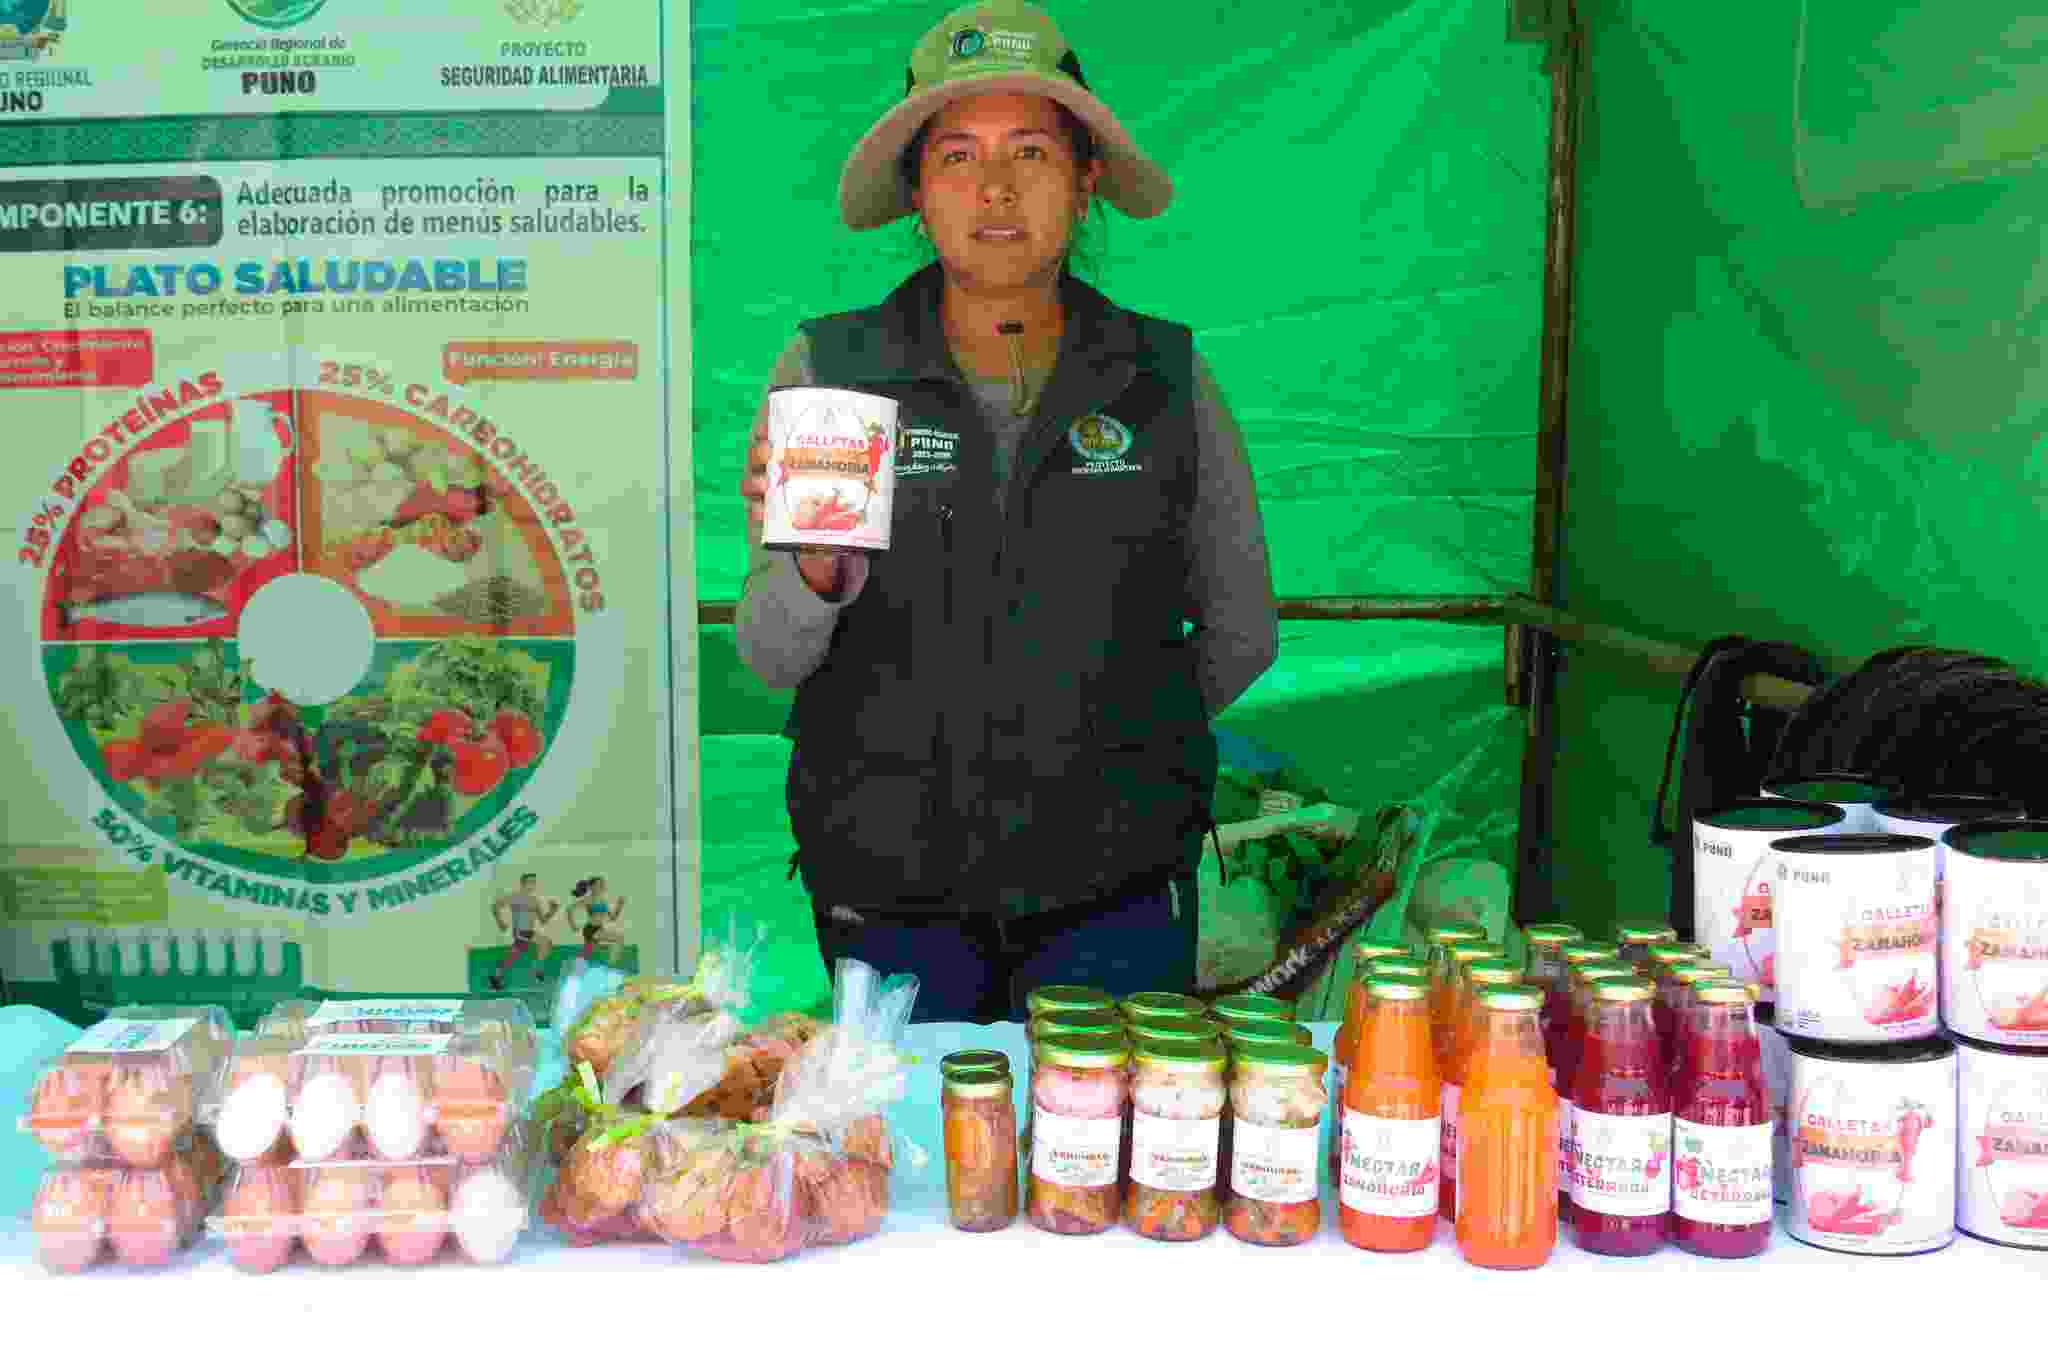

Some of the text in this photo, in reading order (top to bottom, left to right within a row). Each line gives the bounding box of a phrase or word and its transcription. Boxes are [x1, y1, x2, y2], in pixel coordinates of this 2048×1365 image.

[500, 41, 587, 57] PROYECTO
[241, 70, 316, 95] PUNO
[440, 64, 649, 87] SEGURIDAD ALIMENTARIA
[237, 175, 649, 209] Adecuada promoción para la
[179, 201, 208, 225] 6:
[238, 206, 649, 235] elaboración de menús saludables.
[63, 258, 529, 298] PLATO SALUDABLE
[63, 294, 528, 320] El balance perfecto para una alimentación
[52, 370, 224, 500] PROTEÍNAS
[319, 360, 606, 613] 25% CARBOHIDRATOS
[91, 806, 154, 864] 50%
[159, 852, 331, 915] VITAMINAS
[341, 891, 359, 914] Y
[366, 804, 539, 912] MINERALES
